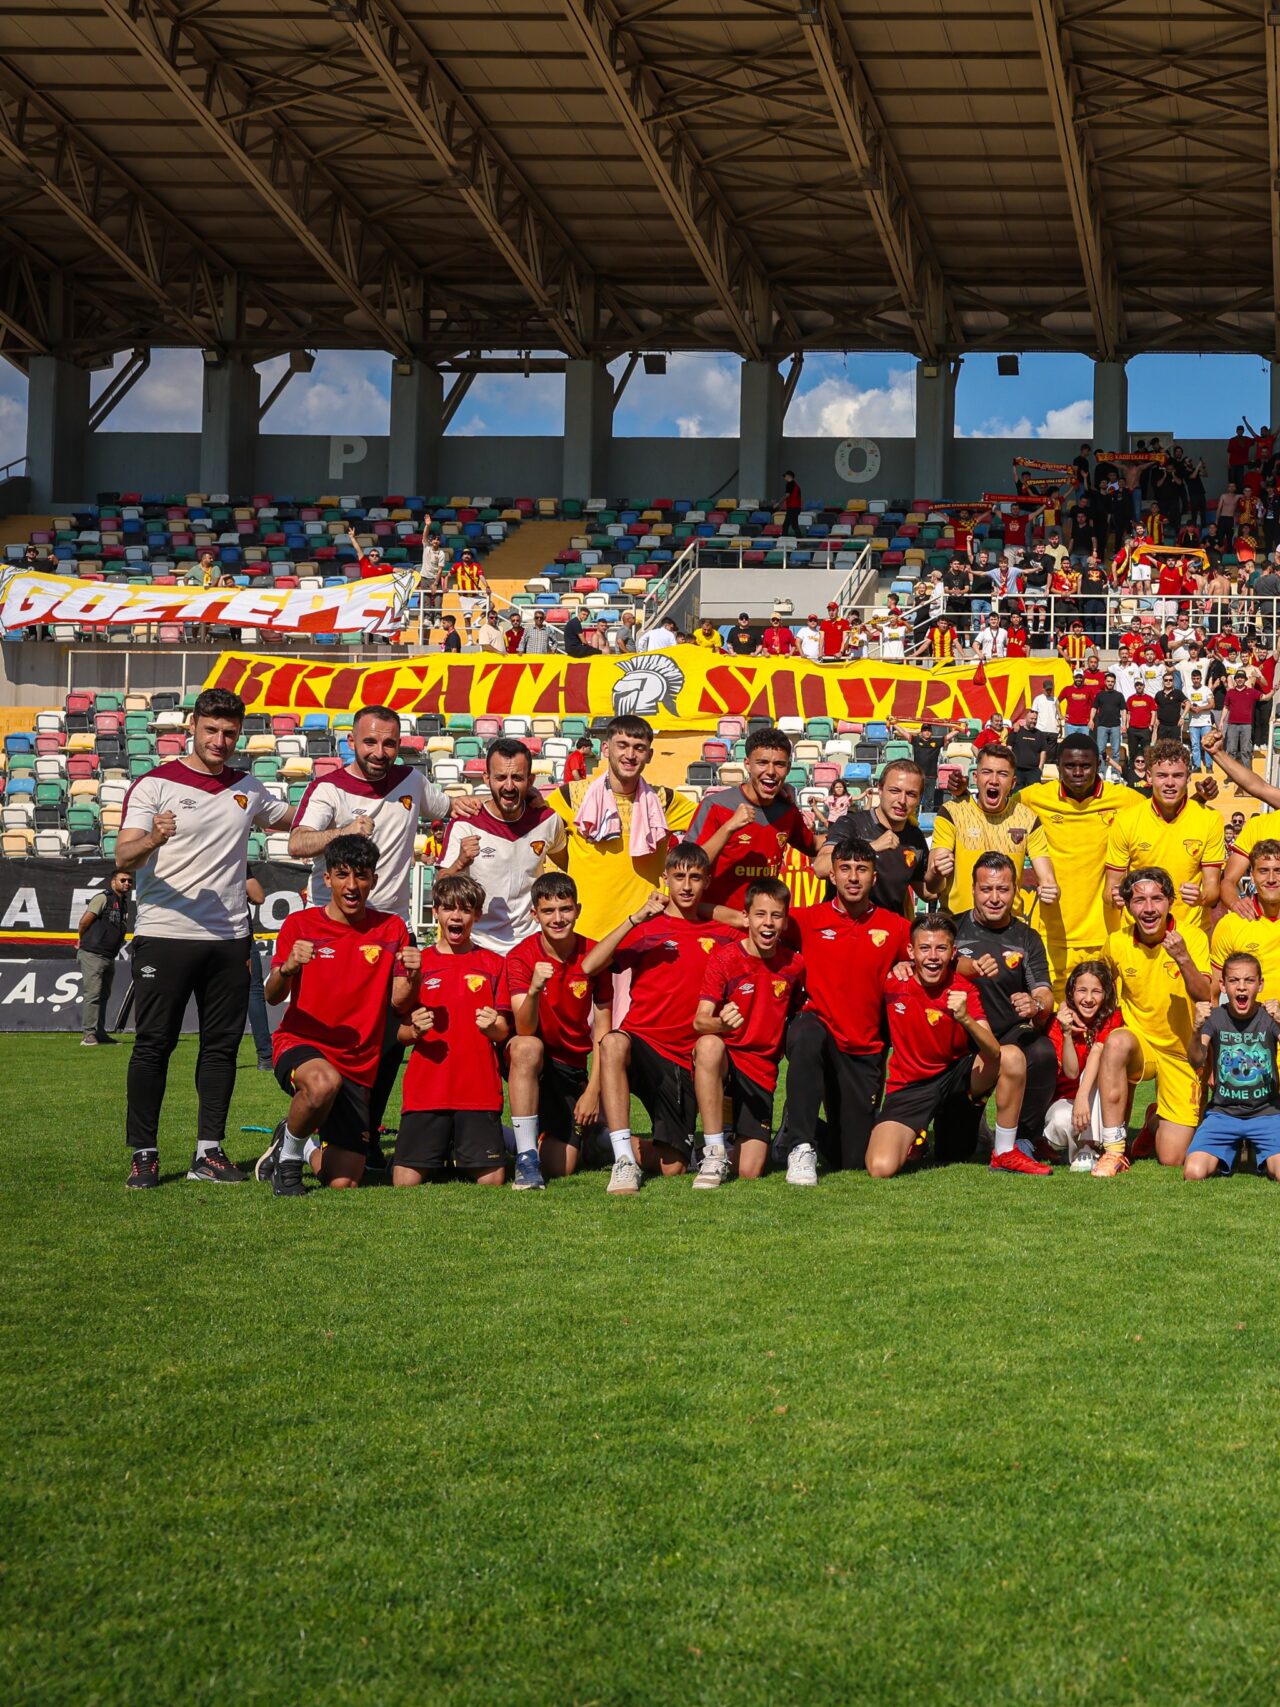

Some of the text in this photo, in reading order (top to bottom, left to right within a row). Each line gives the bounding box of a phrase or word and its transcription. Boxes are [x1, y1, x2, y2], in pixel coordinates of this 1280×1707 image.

[329, 435, 367, 480] P
[834, 438, 882, 484] O
[5, 577, 395, 631] GÖZTEPE
[1219, 1031, 1267, 1044] LET'S PLAY
[1219, 1085, 1249, 1100] GAME
